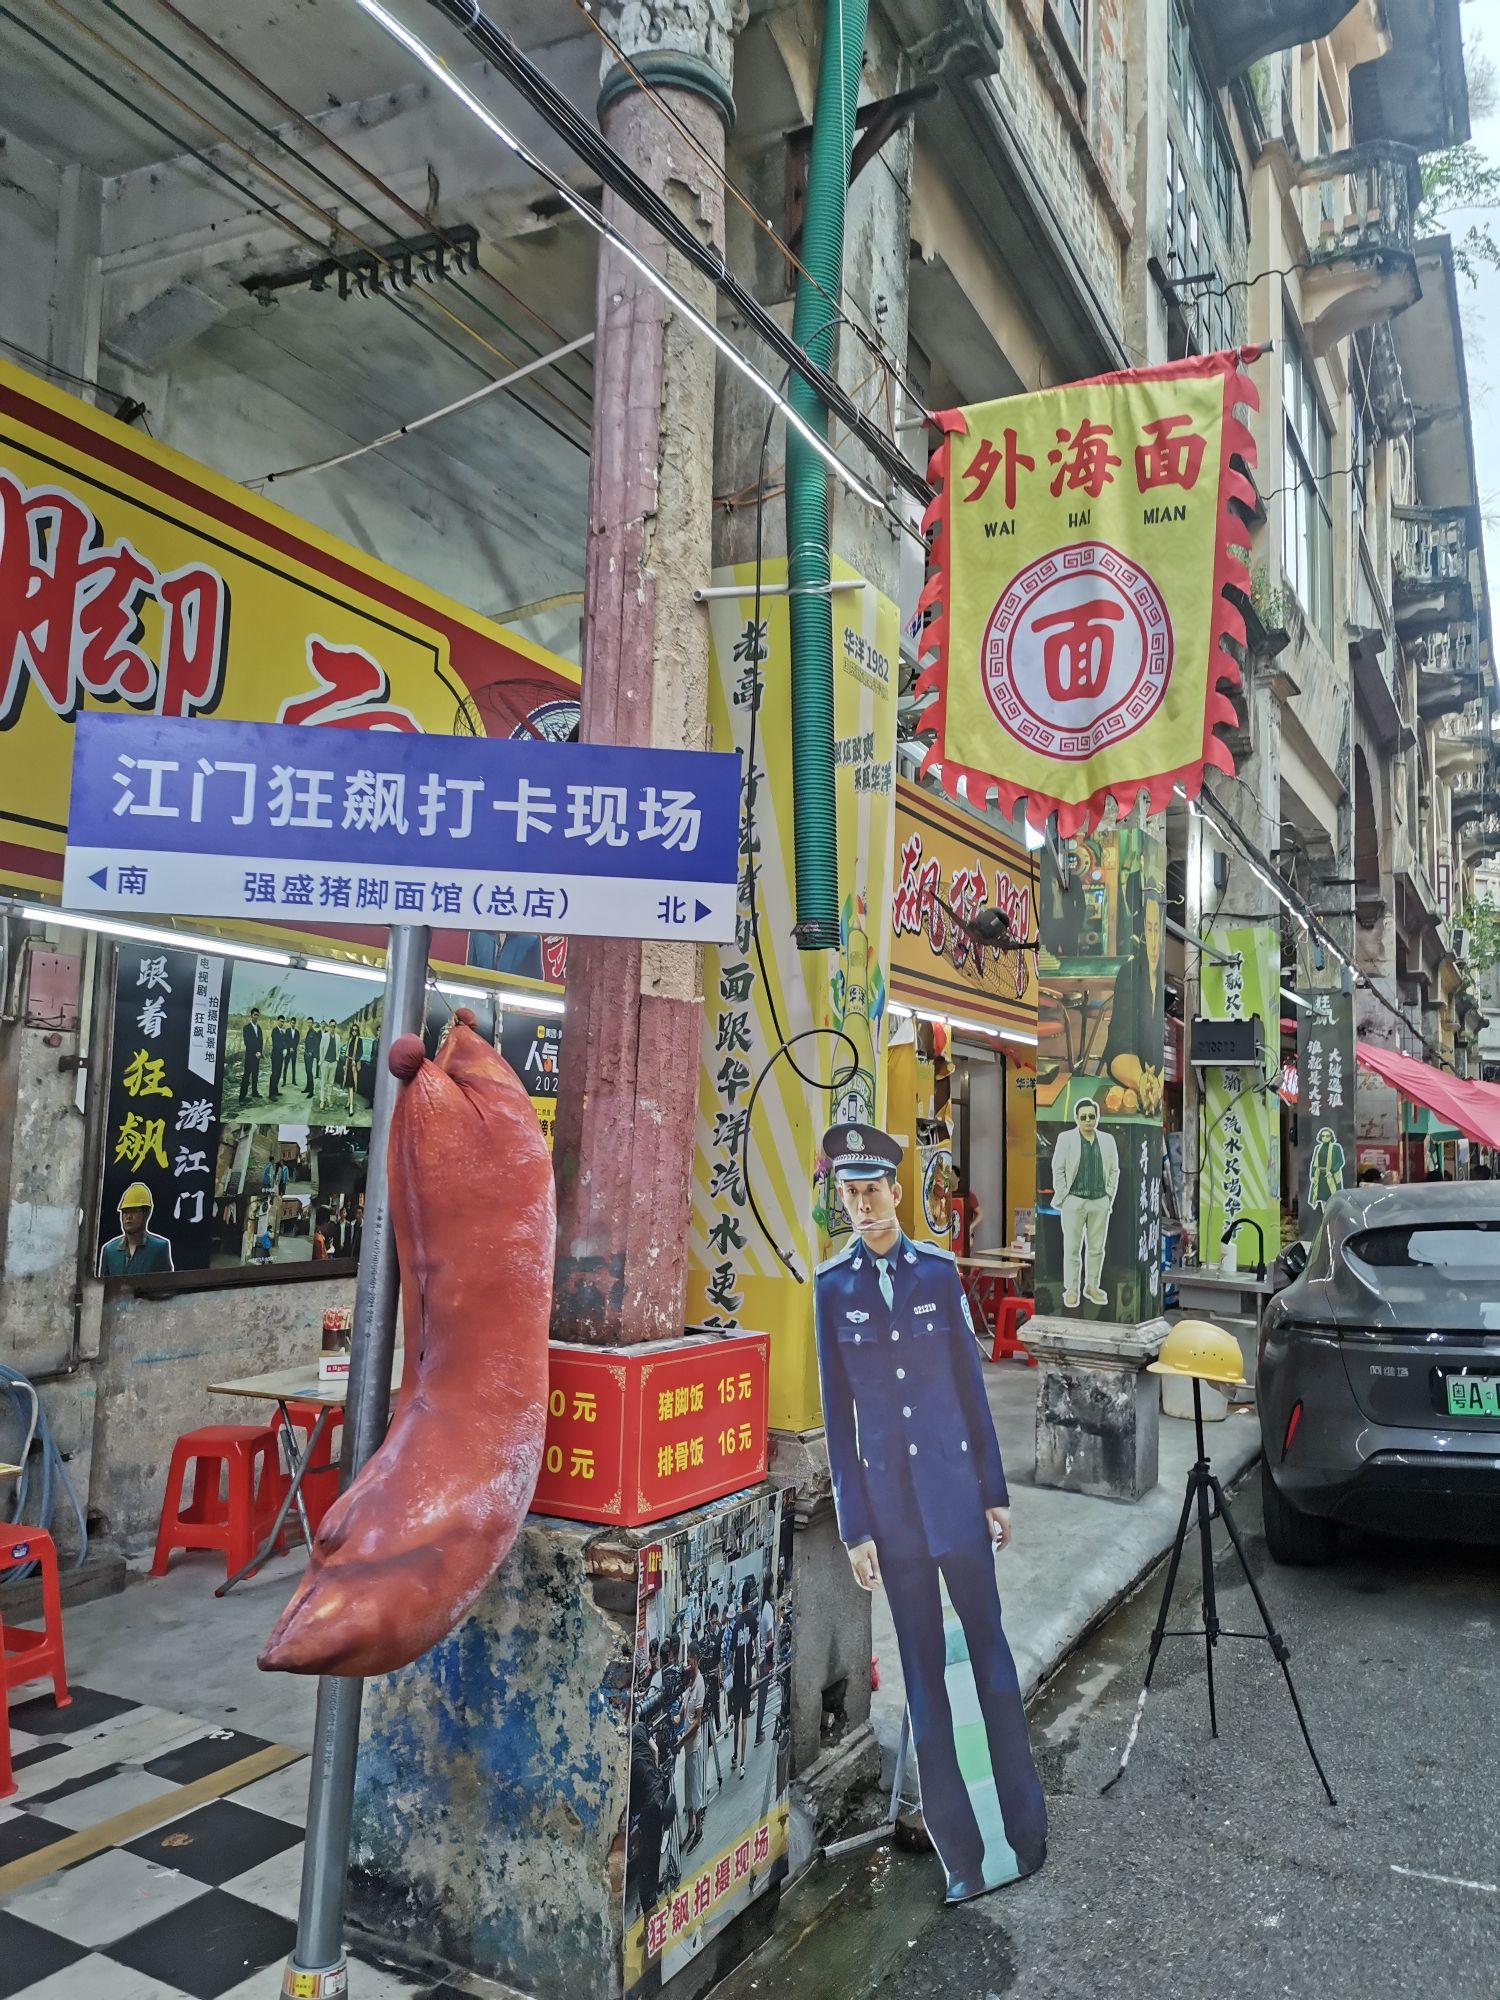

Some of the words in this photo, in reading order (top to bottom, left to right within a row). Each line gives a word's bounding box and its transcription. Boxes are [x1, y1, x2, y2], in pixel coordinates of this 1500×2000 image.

[962, 414, 1207, 509] 外海面
[985, 519, 1015, 537] WAI
[1068, 509, 1091, 528] HAI
[1143, 506, 1186, 525] MIAN
[1031, 600, 1125, 702] 面
[111, 754, 702, 852] 江门狂飙打卡现场
[117, 866, 148, 895] 南
[243, 871, 570, 919] 强盛猪脚面馆(总店)
[657, 896, 686, 924] 北
[205, 996, 219, 1062] 拍摄取景地
[174, 1099, 216, 1223] 游江门
[1148, 1177, 1161, 1297] 猪脚面
[658, 1383, 705, 1421] 猪脚饭
[718, 1373, 752, 1404] 15元
[1453, 1382, 1500, 1409] 粤A
[657, 1436, 705, 1478] 排骨饭
[718, 1423, 752, 1456] 16元
[648, 1825, 769, 1957] 狂飙拍摄现场
